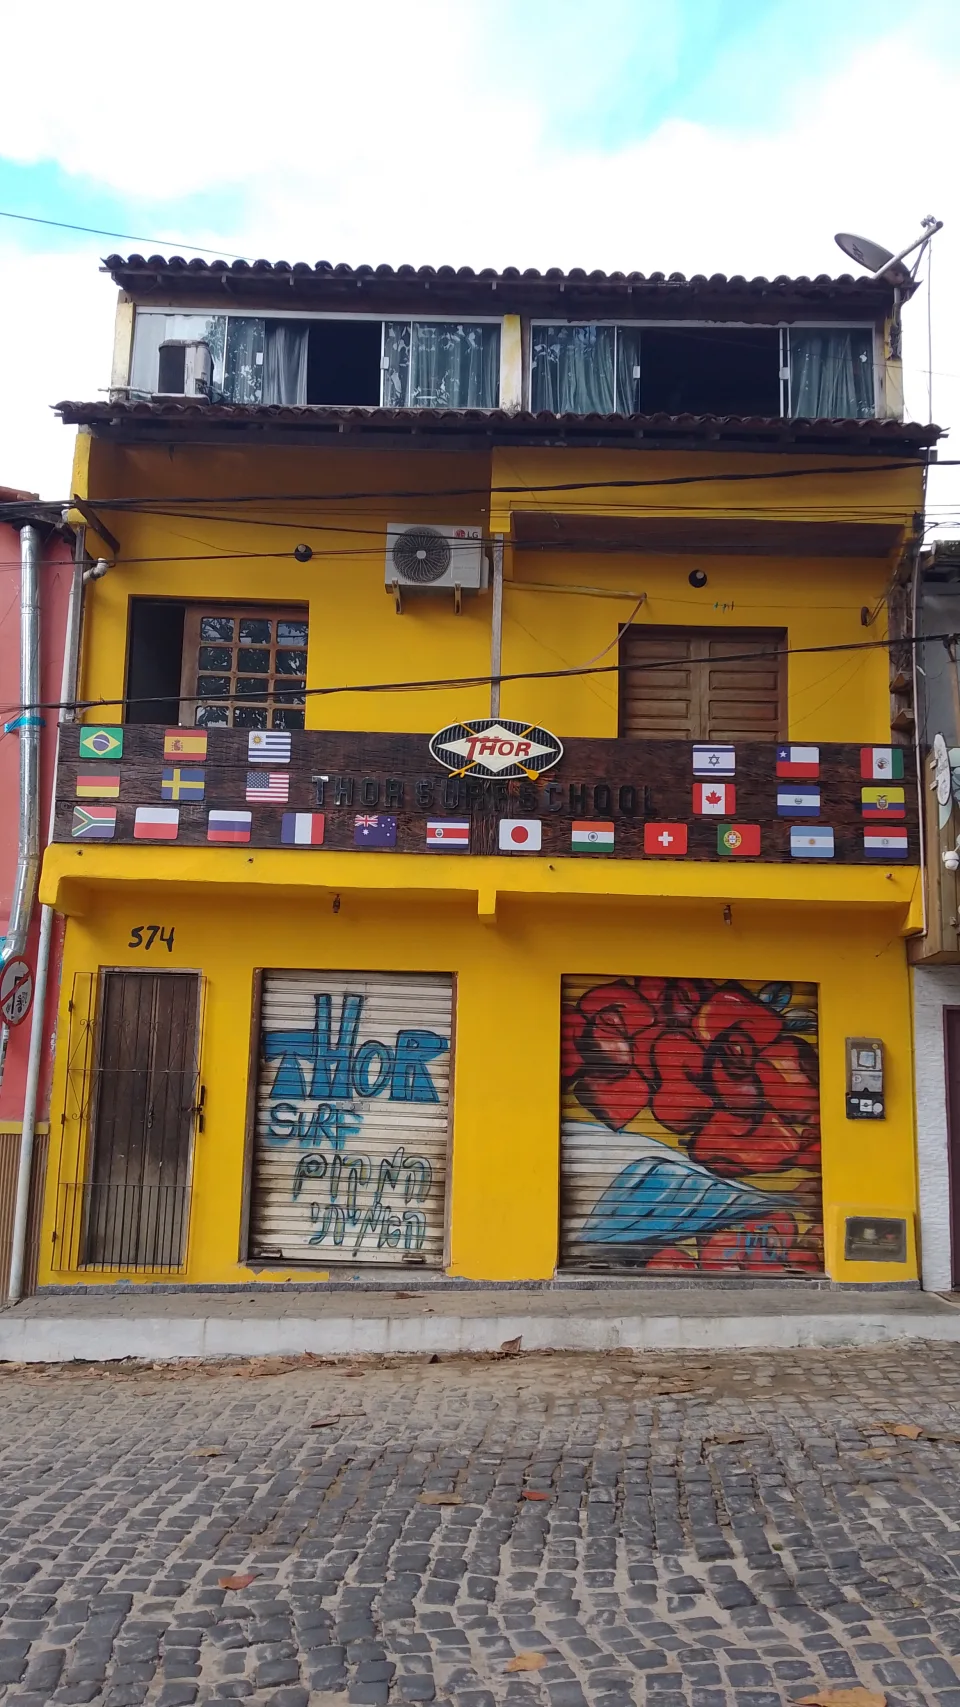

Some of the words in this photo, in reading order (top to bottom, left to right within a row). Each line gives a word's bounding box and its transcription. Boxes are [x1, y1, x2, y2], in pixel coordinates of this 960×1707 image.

[465, 735, 532, 760] THOR
[311, 775, 405, 809] THOR
[415, 778, 511, 813] SURF
[517, 781, 658, 817] SCHOOL
[128, 925, 175, 952] 574
[262, 993, 449, 1103] THOR
[269, 1102, 364, 1150] SURF
